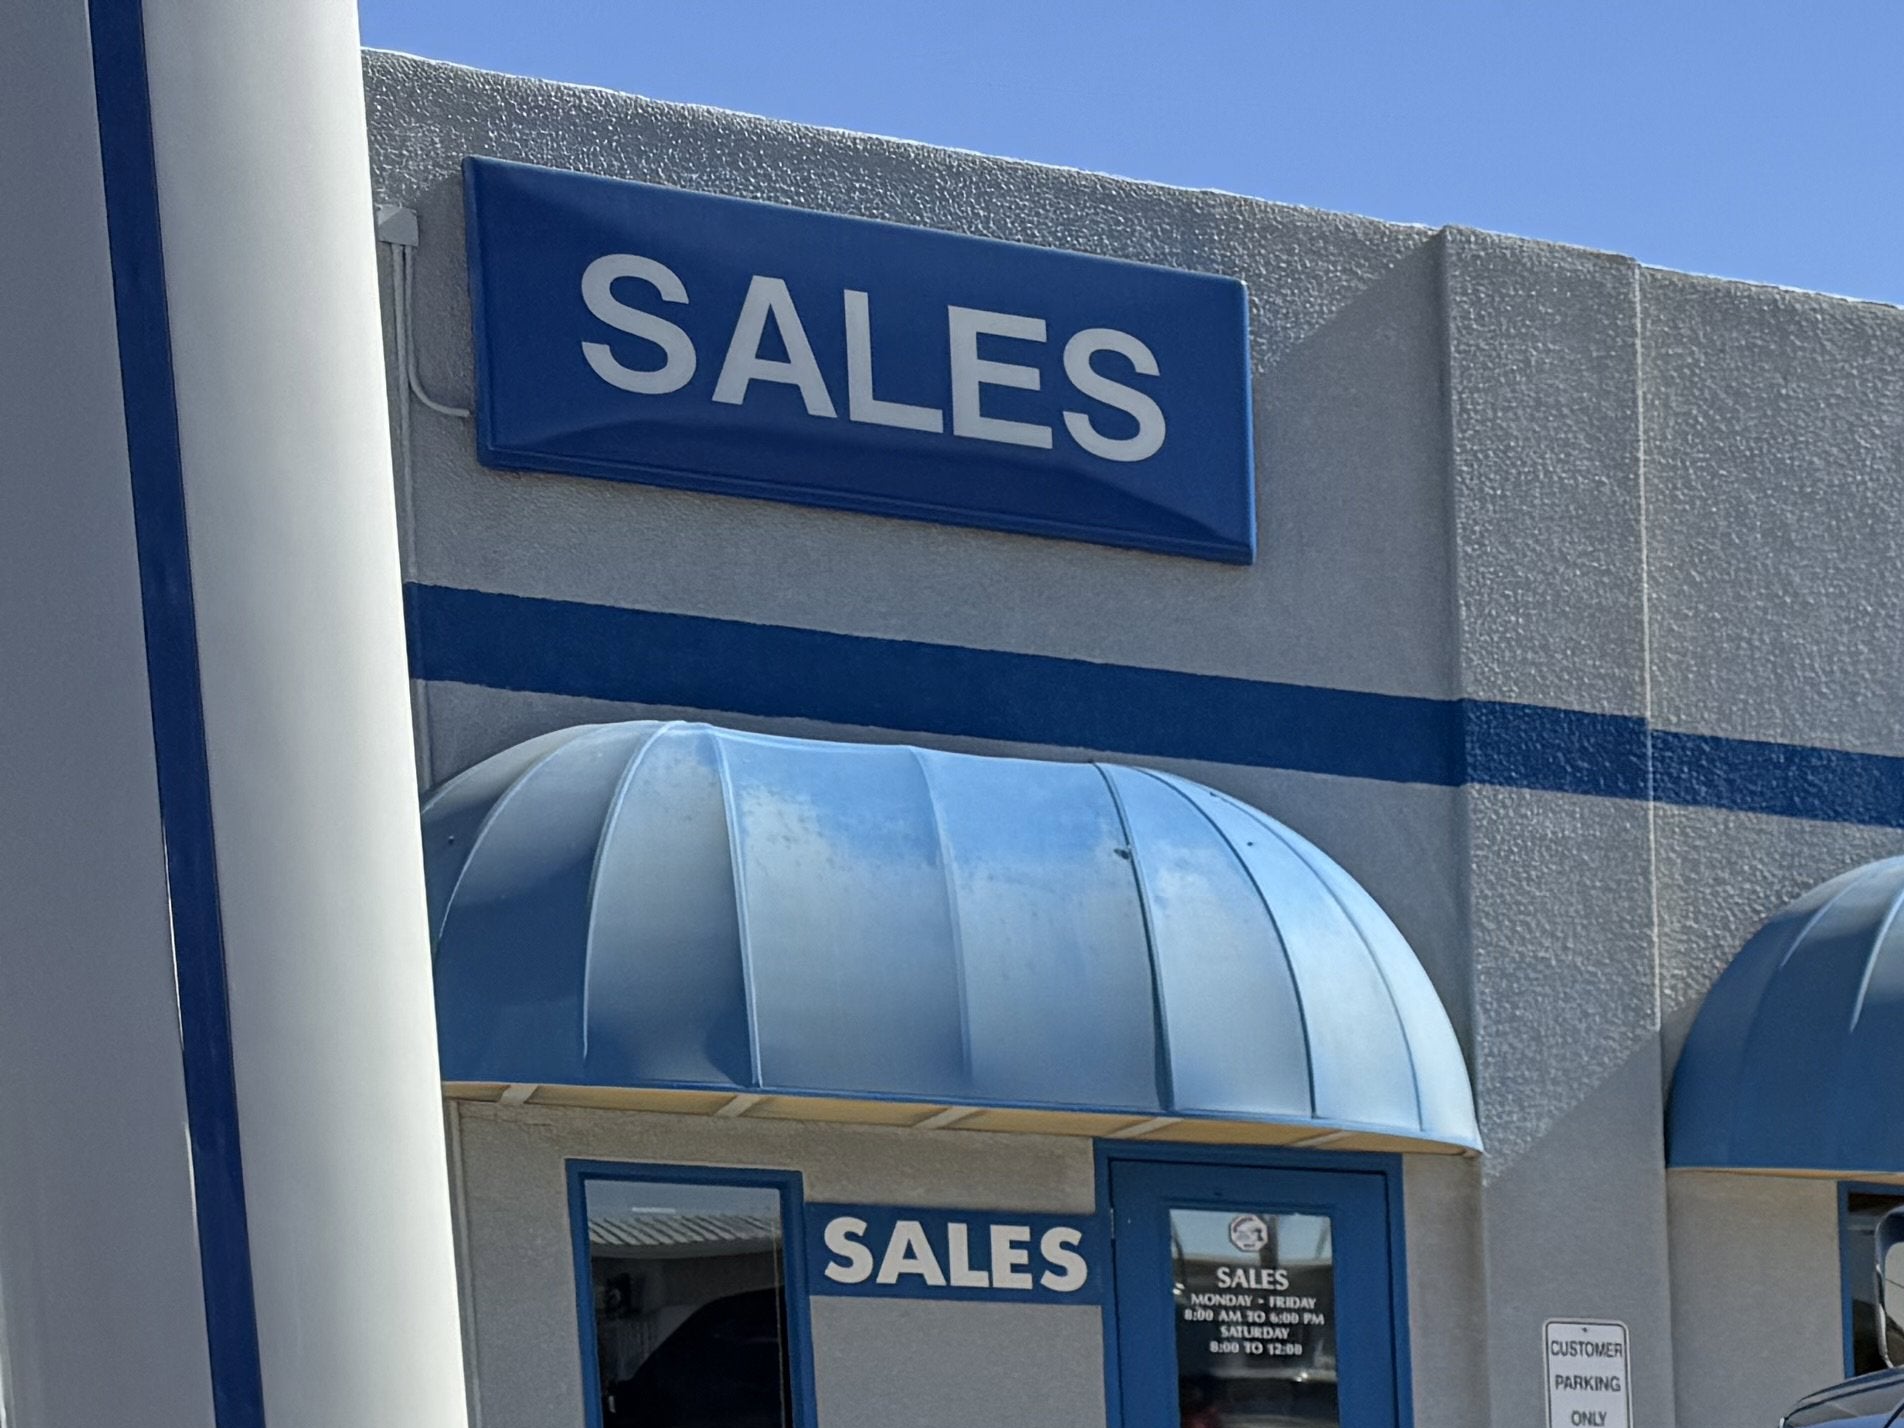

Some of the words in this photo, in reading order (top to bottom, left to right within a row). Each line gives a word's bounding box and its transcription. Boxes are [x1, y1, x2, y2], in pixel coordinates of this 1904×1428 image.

[581, 254, 1166, 462] SALES
[824, 1216, 1088, 1292] SALES
[1216, 1266, 1290, 1291] SALES
[1191, 1293, 1253, 1307] MONDAY
[1269, 1296, 1317, 1310] FRIDAY
[1184, 1309, 1214, 1321] 8:00
[1218, 1310, 1242, 1322] AM
[1246, 1310, 1266, 1323] TO
[1303, 1313, 1325, 1325] PM
[1220, 1326, 1290, 1340] SATURDAY
[1209, 1341, 1240, 1353] 8:00
[1243, 1342, 1263, 1354] TO
[1550, 1340, 1622, 1358] CUSTOMER
[1555, 1374, 1621, 1392] PARKING
[1571, 1410, 1607, 1427] ONLY
